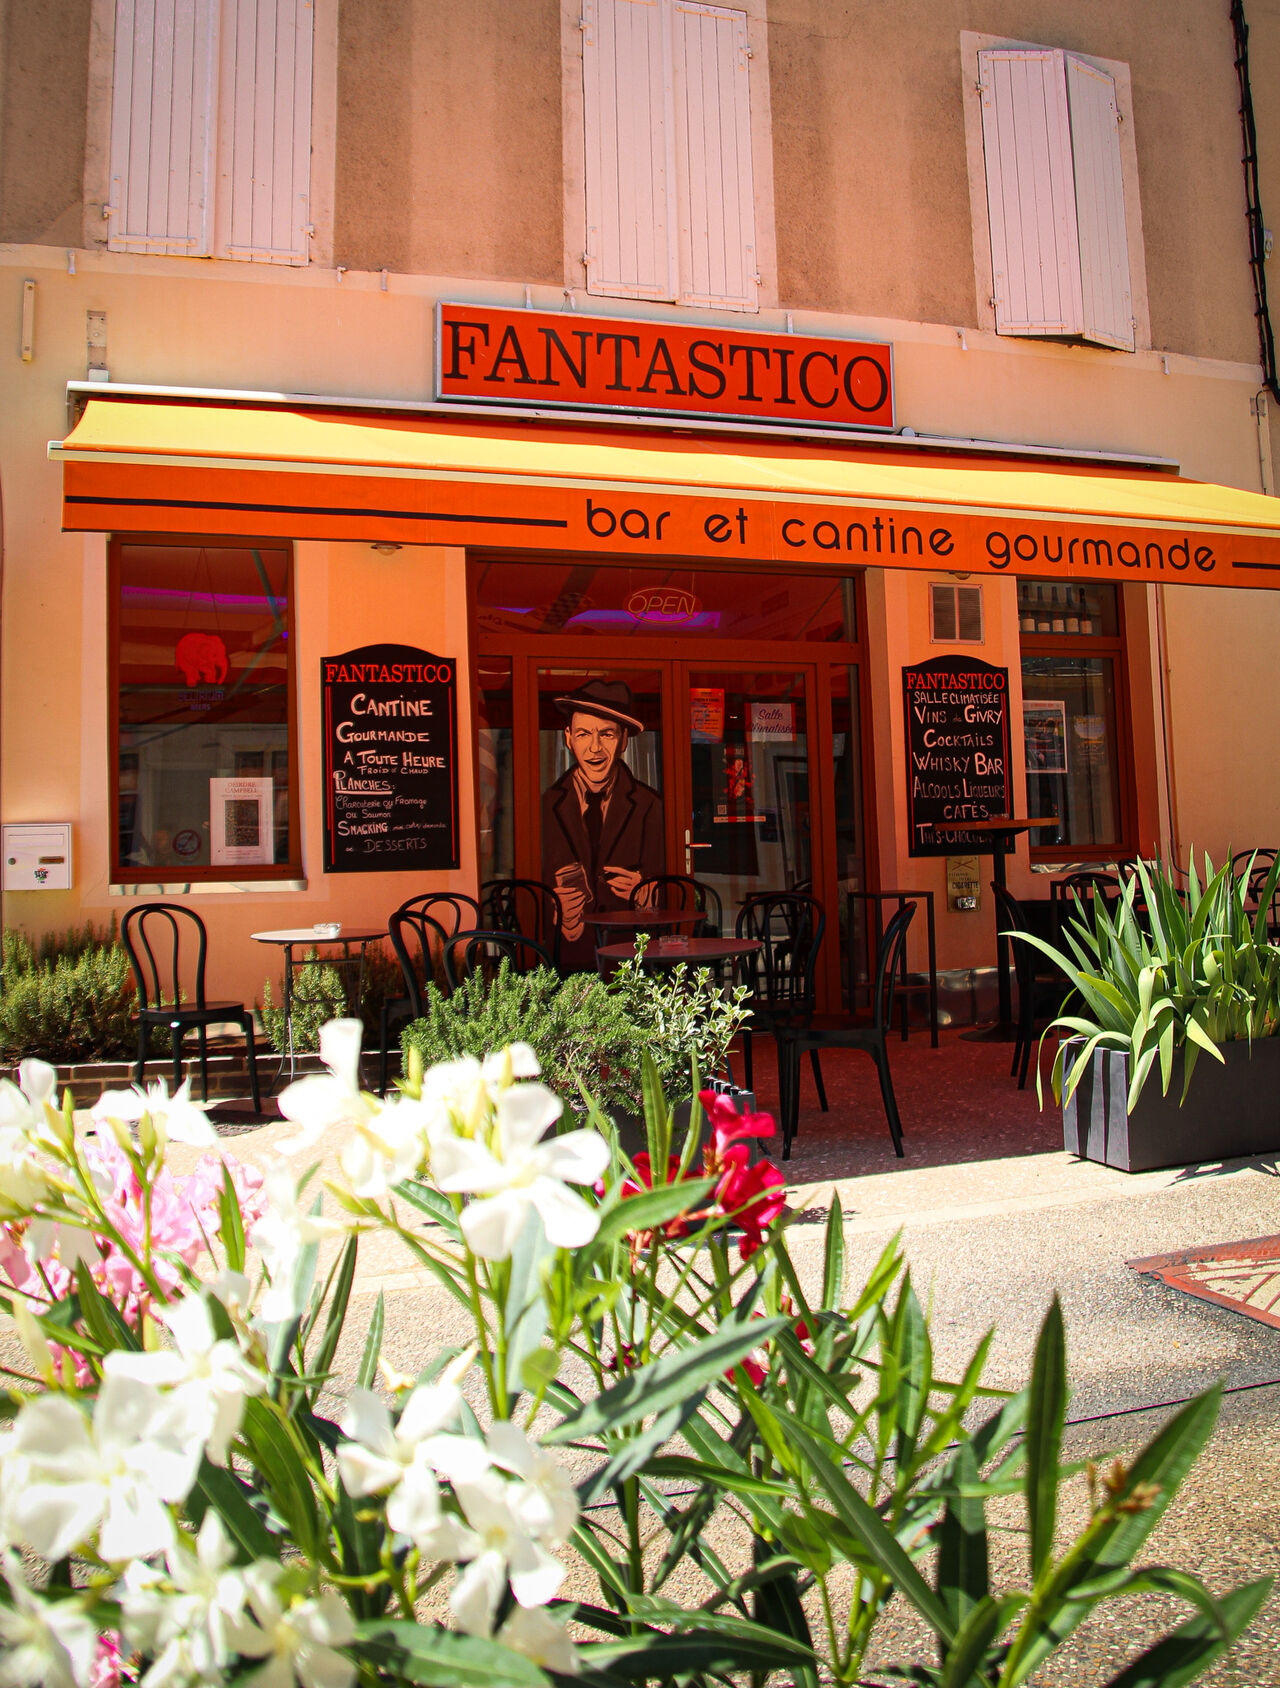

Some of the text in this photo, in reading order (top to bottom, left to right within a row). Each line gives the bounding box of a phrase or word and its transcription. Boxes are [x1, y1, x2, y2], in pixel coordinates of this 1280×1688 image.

[443, 321, 889, 412] FANTASTICO
[586, 498, 1216, 573] bar et cantine gourmande
[628, 595, 696, 616] OPEN
[325, 664, 452, 683] FANTASTICO
[906, 673, 1005, 690] FANTASTICO
[350, 693, 433, 717] CANTINE
[758, 708, 784, 720] Salle
[914, 705, 947, 725] VINS
[336, 721, 430, 743] GOURMANDE
[923, 729, 994, 748] COCKTAILS
[344, 750, 446, 768] A TOUTE HEURE
[912, 751, 1004, 776] WHISKY BAR
[913, 775, 961, 799] ALCOOLS
